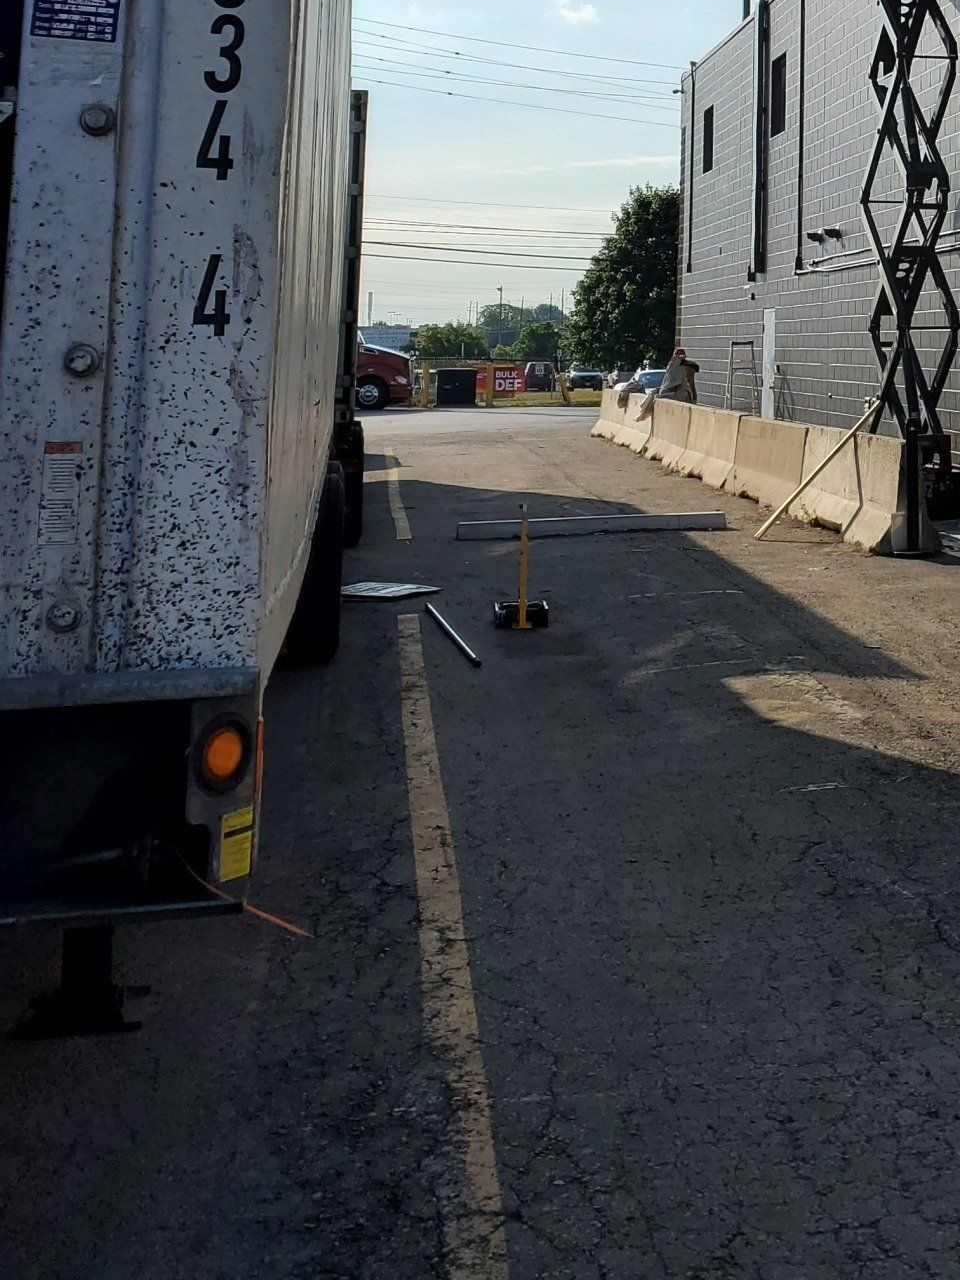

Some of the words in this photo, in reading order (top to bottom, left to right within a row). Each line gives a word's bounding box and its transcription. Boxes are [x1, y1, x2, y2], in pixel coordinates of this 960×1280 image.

[191, 253, 231, 337] 4
[495, 370, 518, 378] BULK
[495, 379, 522, 391] DEF
